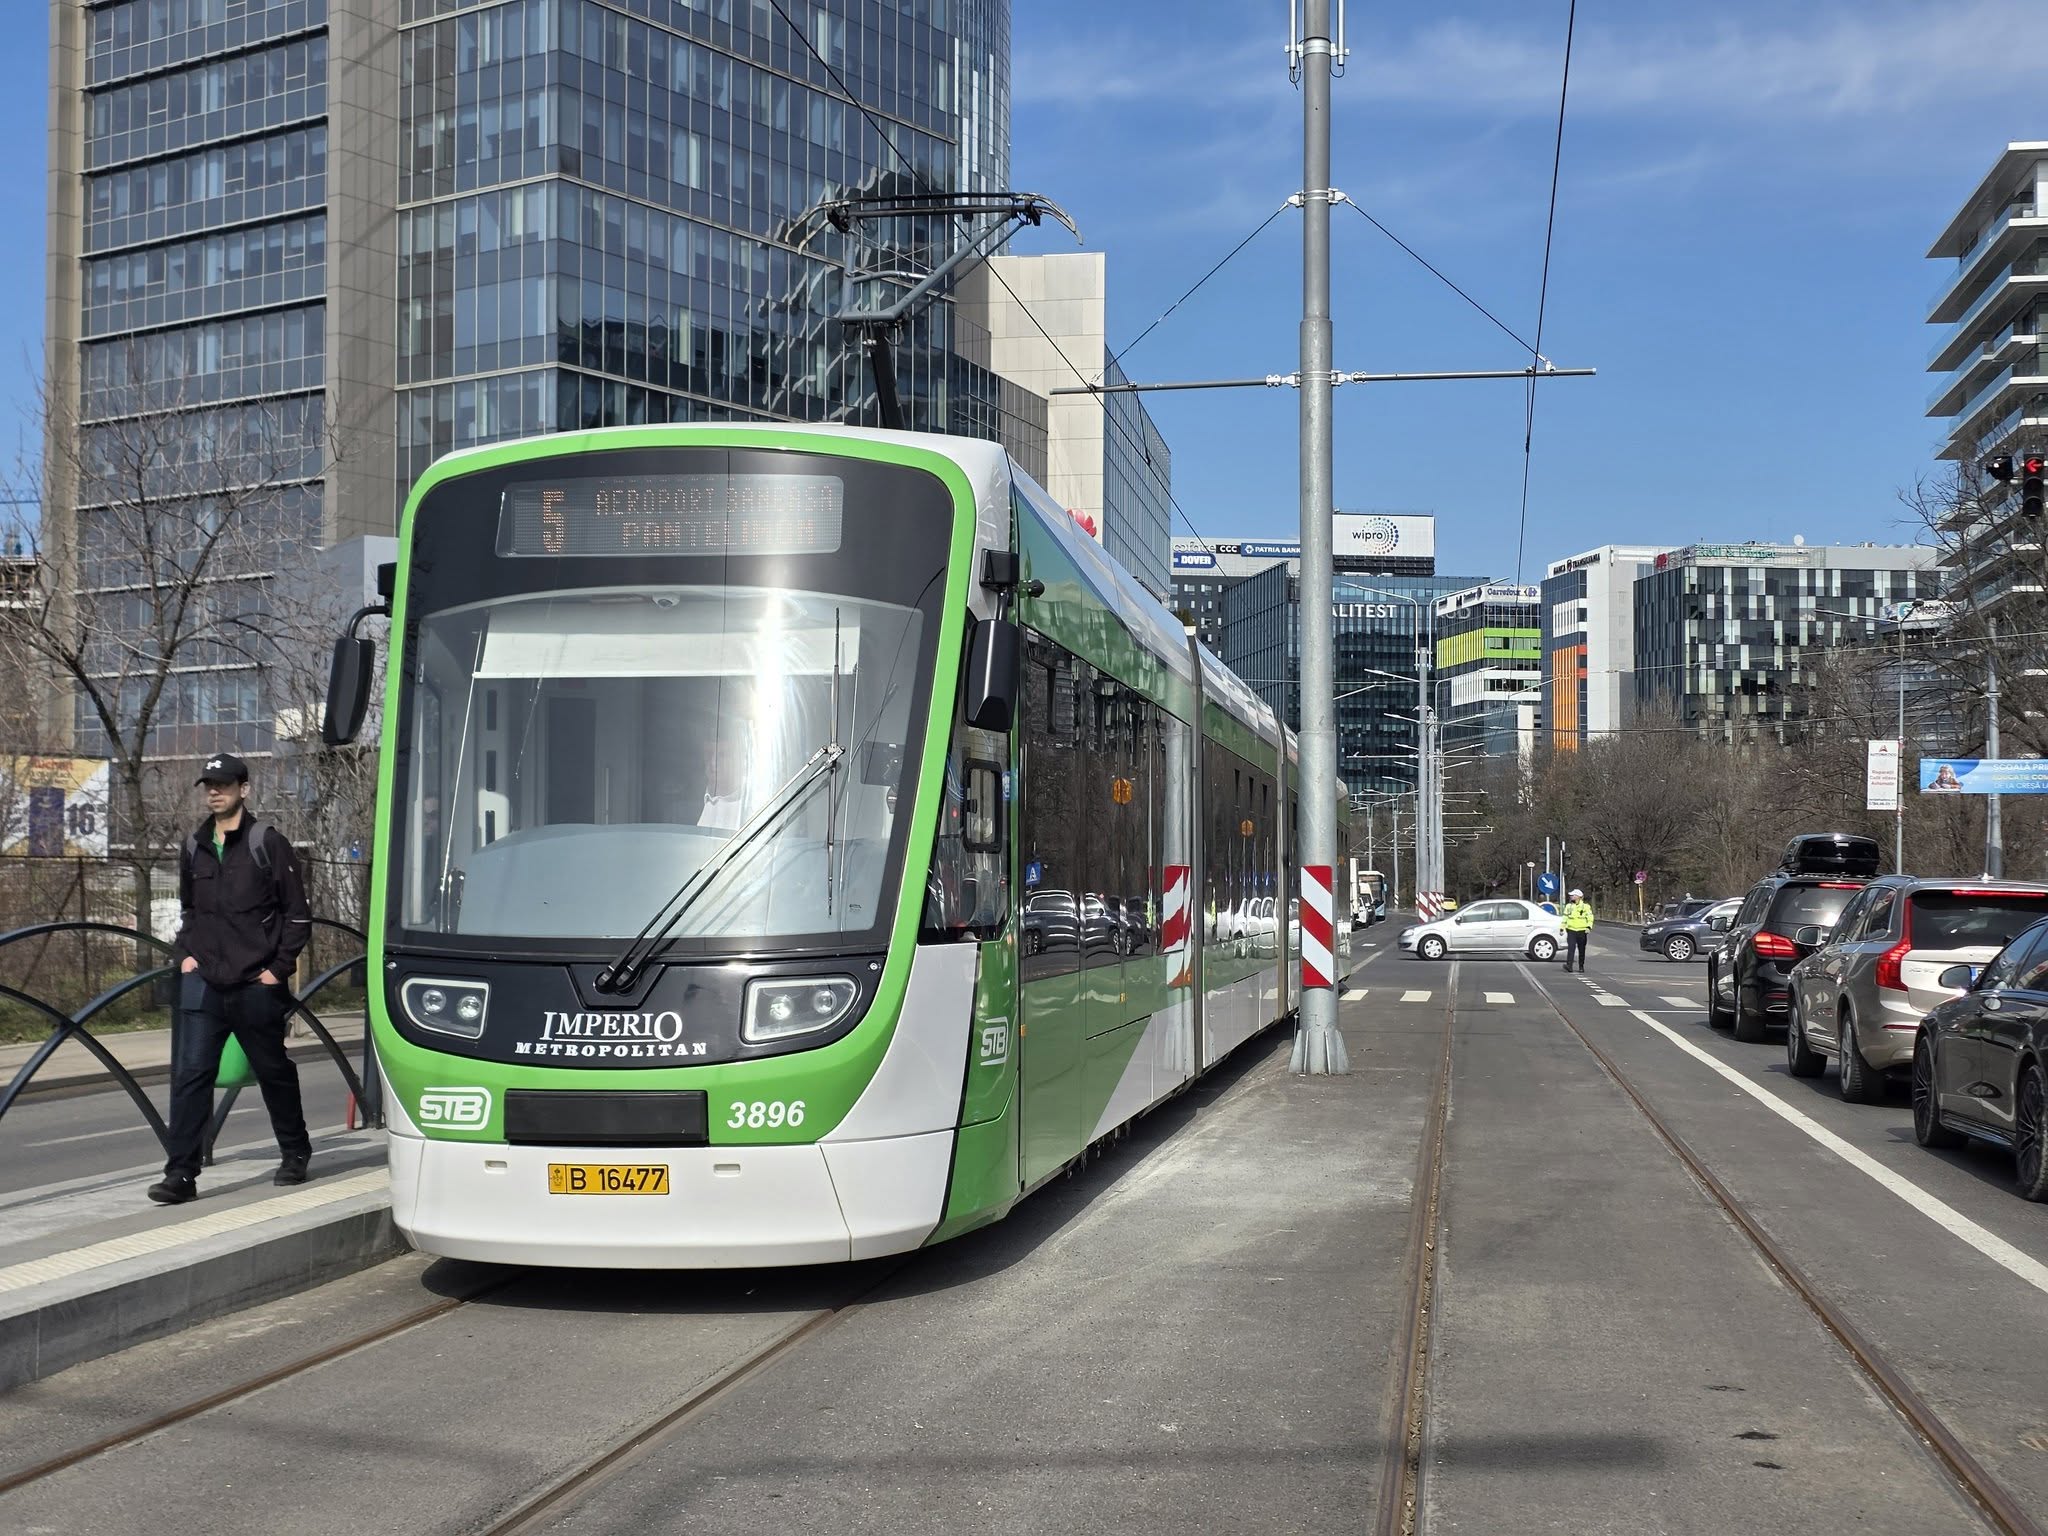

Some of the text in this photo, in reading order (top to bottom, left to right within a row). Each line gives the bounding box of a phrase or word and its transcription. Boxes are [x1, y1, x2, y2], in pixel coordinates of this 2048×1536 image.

[596, 486, 715, 516] AEROPORT
[542, 490, 566, 553] 5
[1352, 529, 1383, 542] wipro
[1181, 555, 1212, 565] DOVER
[1219, 545, 1238, 553] CCC
[1255, 546, 1280, 554] PATRIA
[1487, 588, 1521, 596] Carrefour
[539, 1011, 683, 1042] IMPERIO
[515, 1042, 707, 1058] METROPOLITAN
[980, 1026, 1006, 1057] STB
[419, 1095, 484, 1122] STB
[727, 1101, 806, 1129] 3896
[570, 1167, 665, 1192] B 16477
